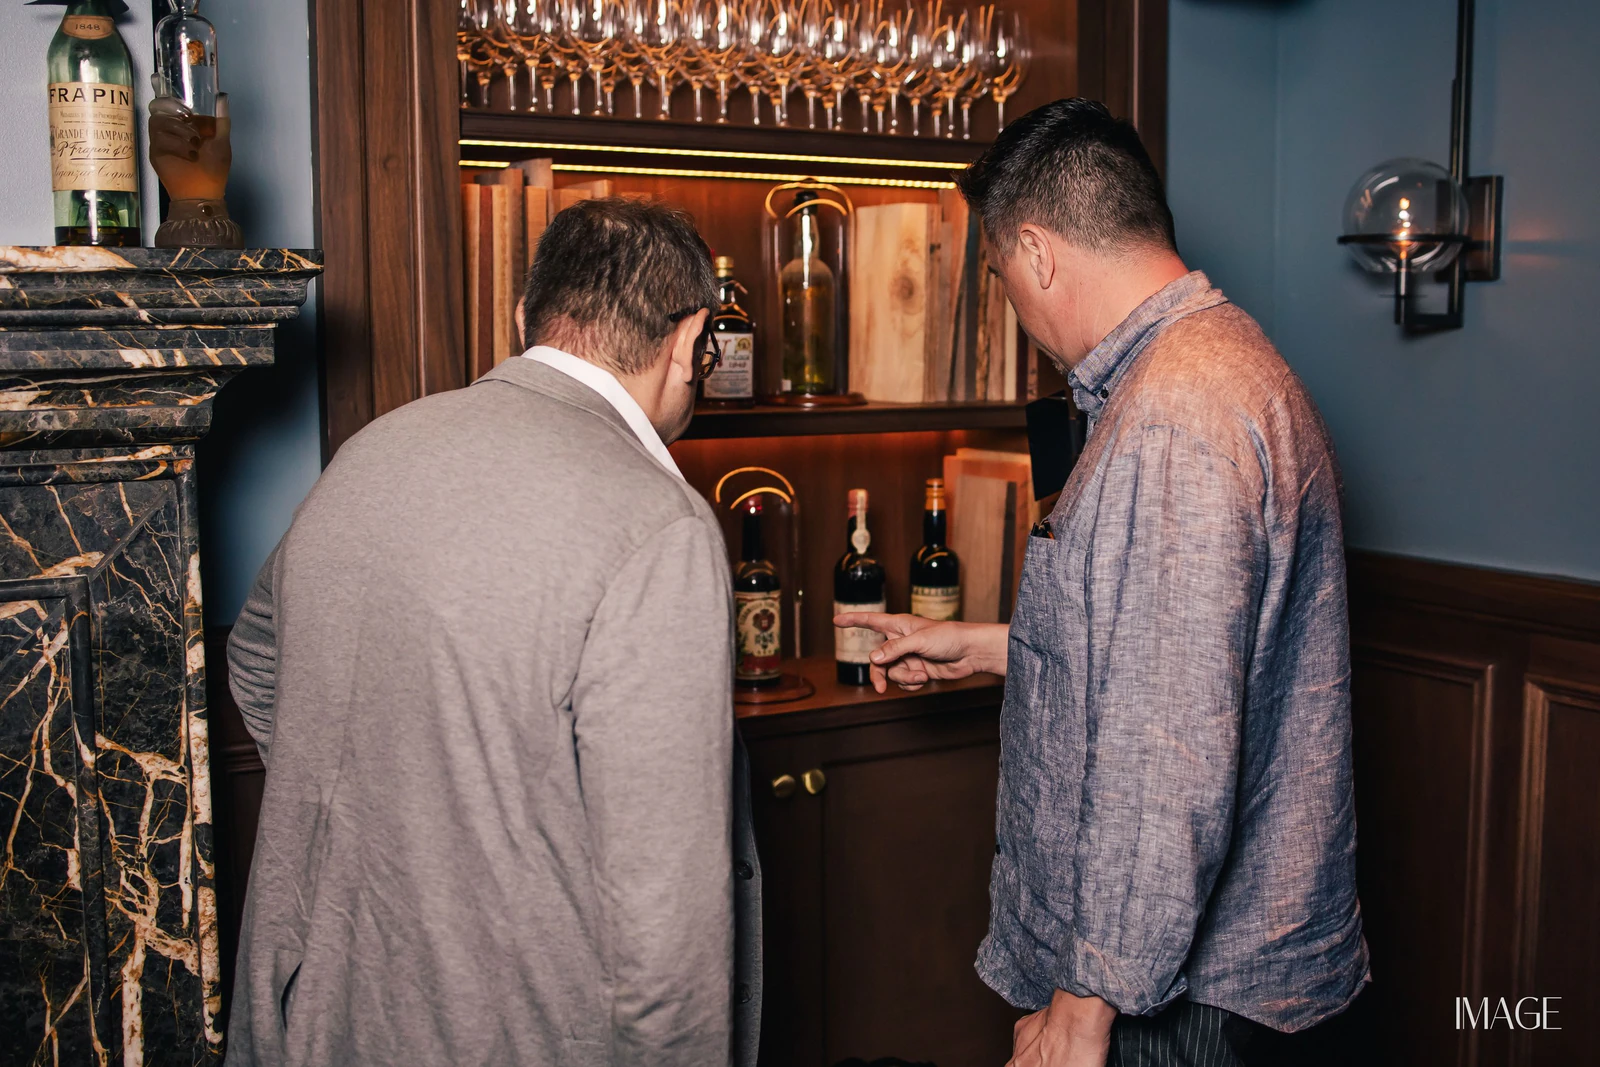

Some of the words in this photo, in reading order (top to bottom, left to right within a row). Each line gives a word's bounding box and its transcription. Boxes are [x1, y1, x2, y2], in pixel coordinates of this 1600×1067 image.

[75, 23, 101, 31] 1848
[49, 87, 129, 106] FRAPIN
[55, 126, 85, 140] GRANDE
